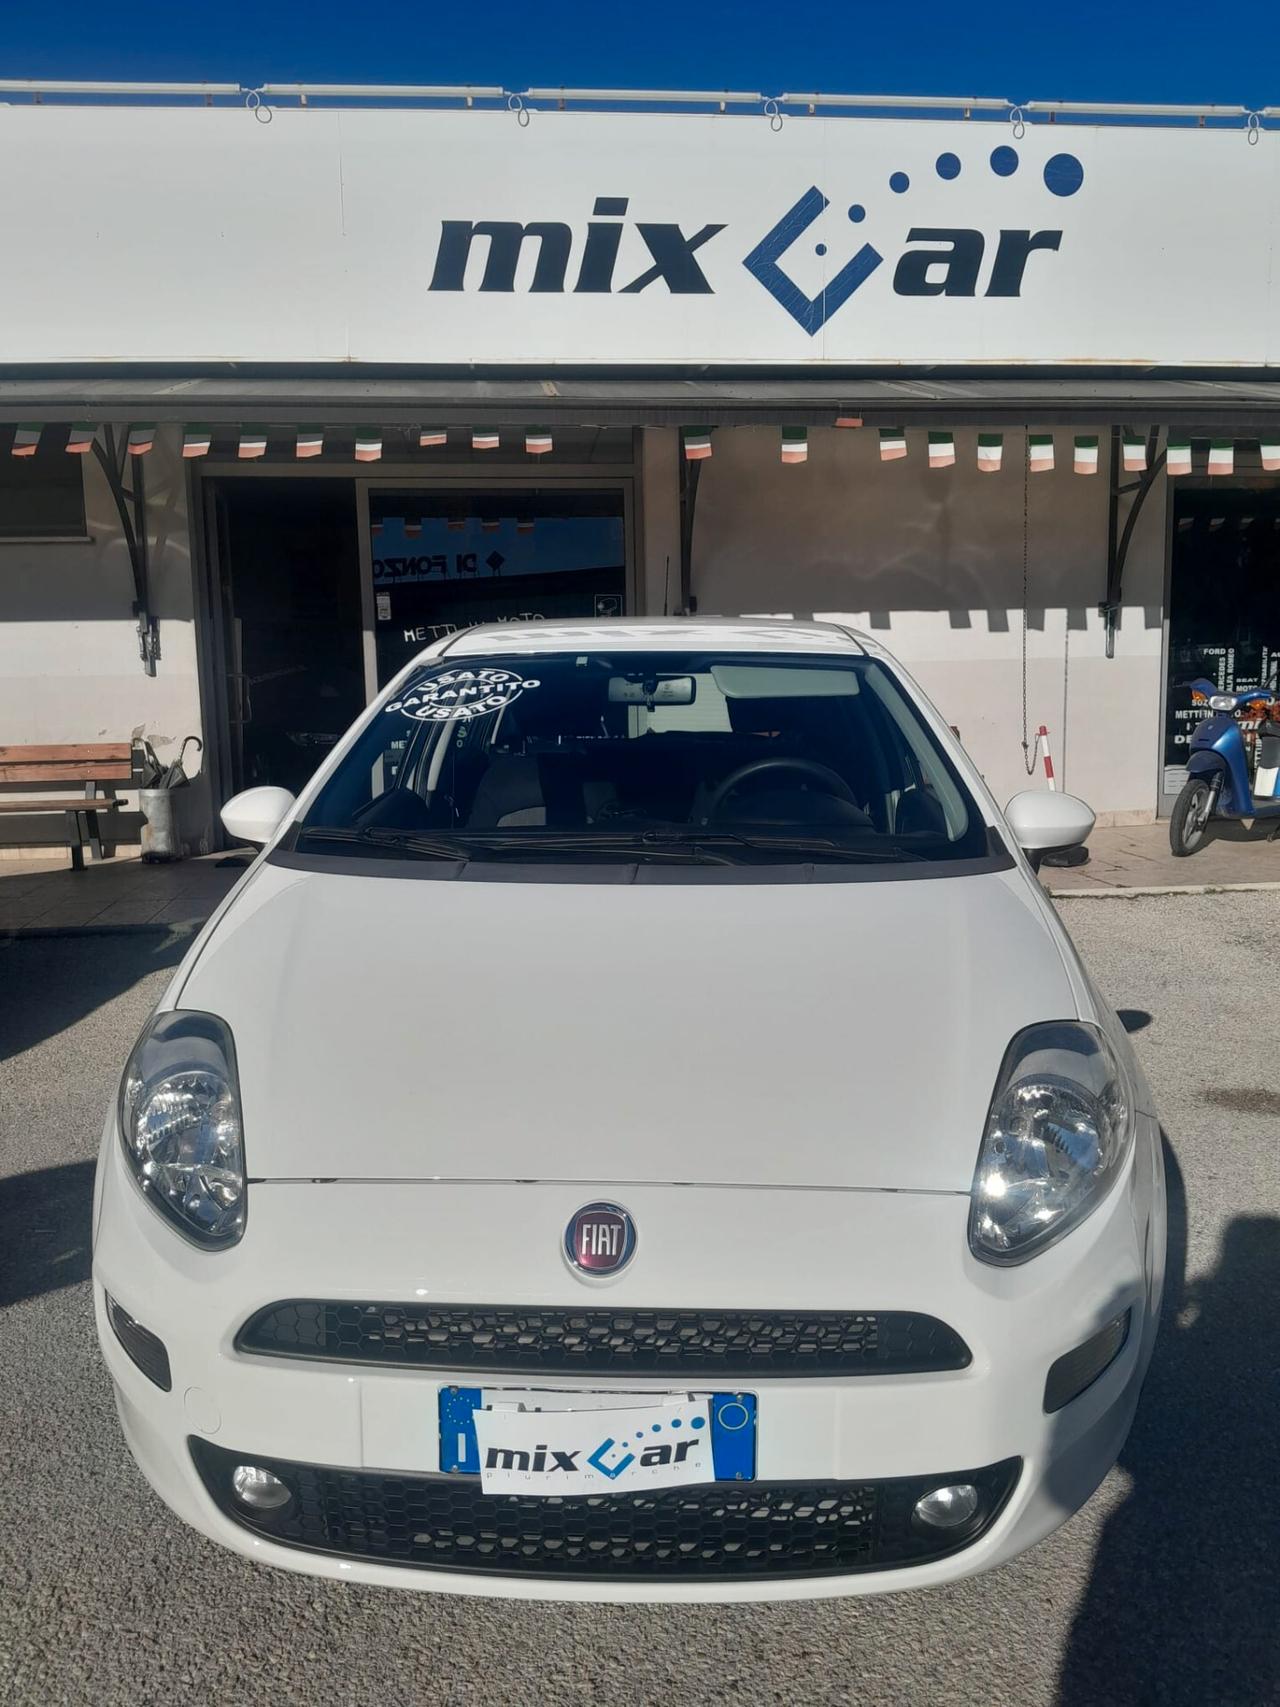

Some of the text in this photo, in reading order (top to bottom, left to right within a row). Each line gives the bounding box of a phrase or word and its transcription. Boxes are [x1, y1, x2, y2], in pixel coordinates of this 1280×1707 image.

[384, 679, 541, 713] GARANTITO
[415, 694, 508, 719] USATO
[581, 1223, 621, 1256] FIAT
